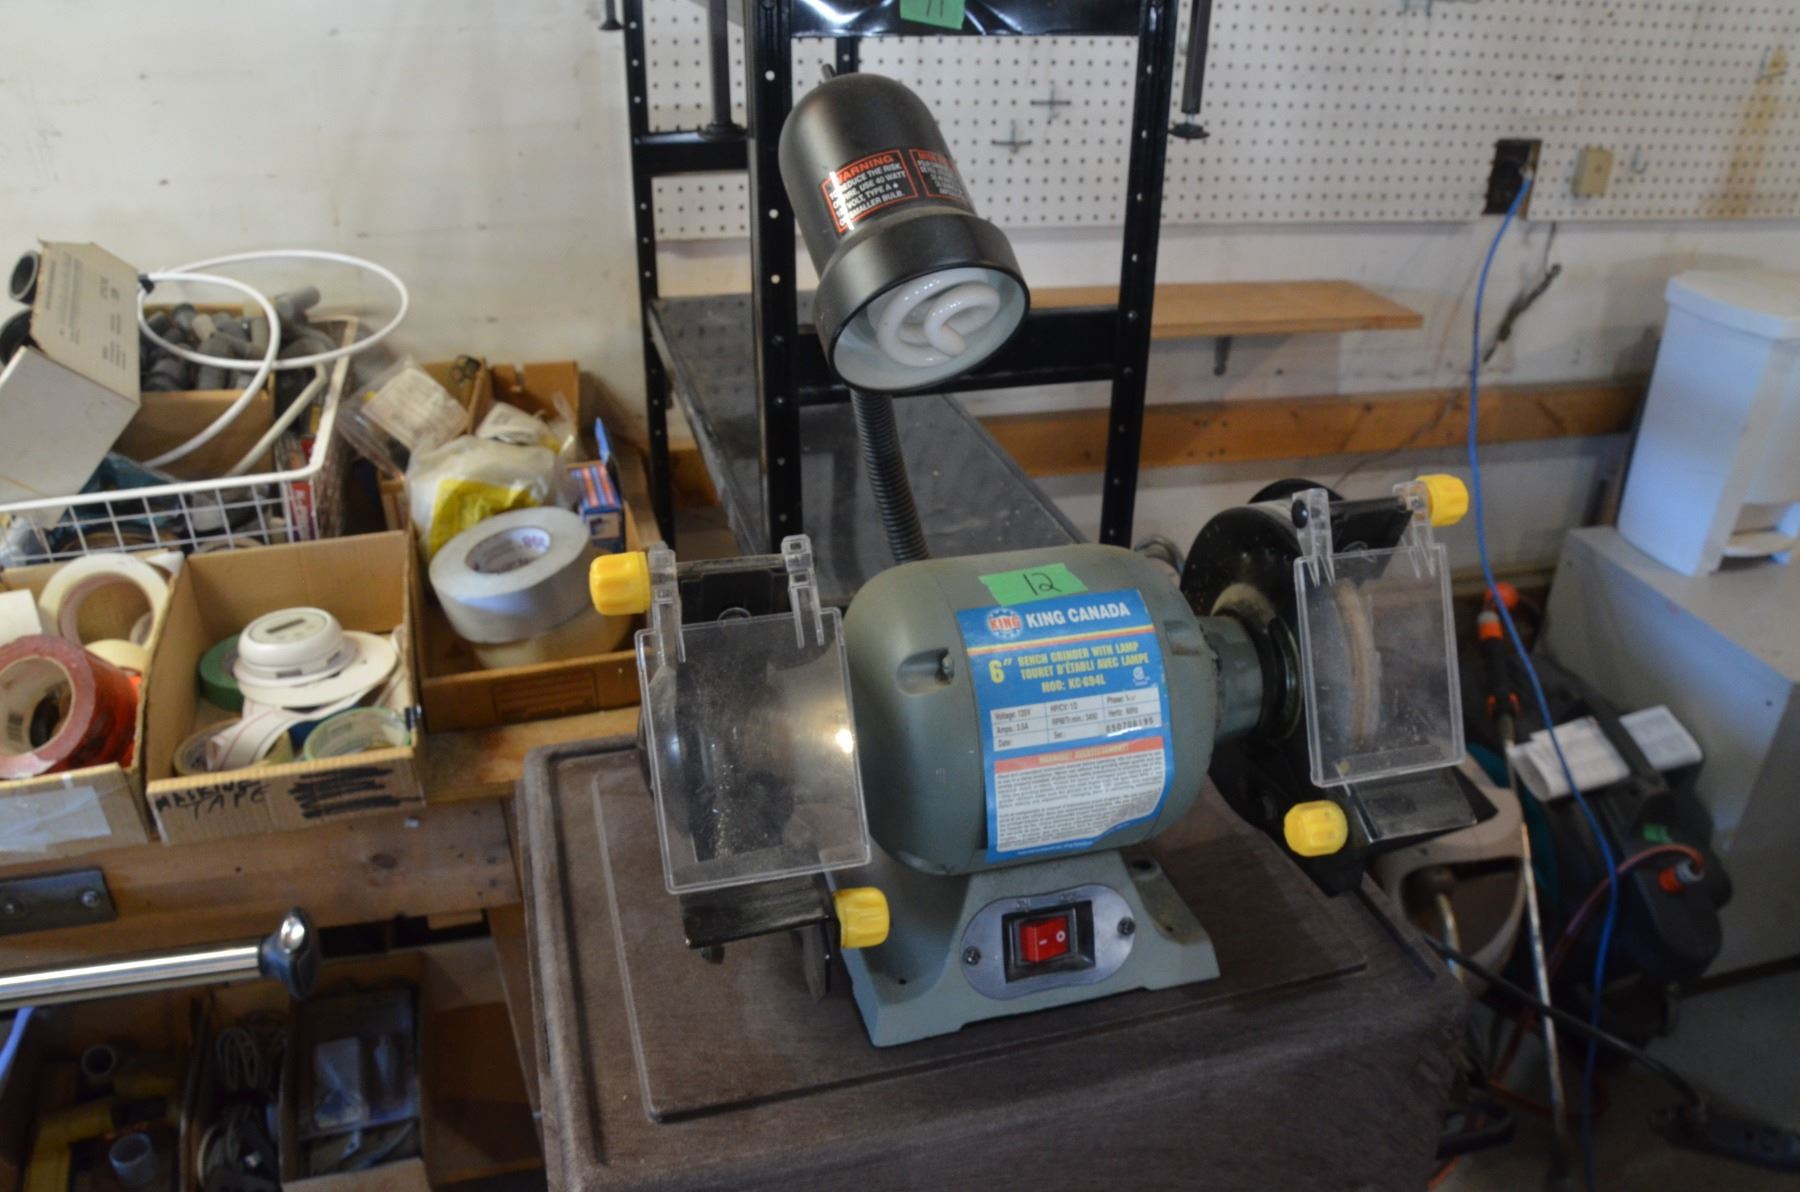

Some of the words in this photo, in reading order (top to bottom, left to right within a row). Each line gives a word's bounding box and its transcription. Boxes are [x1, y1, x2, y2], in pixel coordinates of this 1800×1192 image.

[859, 178, 876, 192] USE
[884, 170, 907, 181] WATT
[864, 185, 885, 199] TYPE
[1022, 572, 1062, 597] 12
[988, 613, 1023, 632] KING
[1025, 609, 1066, 629] KING
[1067, 602, 1131, 623] CANADA
[1017, 653, 1049, 667] BENCH
[1050, 648, 1090, 663] GRINDER
[1090, 644, 1114, 657] WITH
[1114, 641, 1139, 654] LAMP
[1097, 656, 1120, 670] AVEC
[1121, 652, 1150, 667] LAMPE
